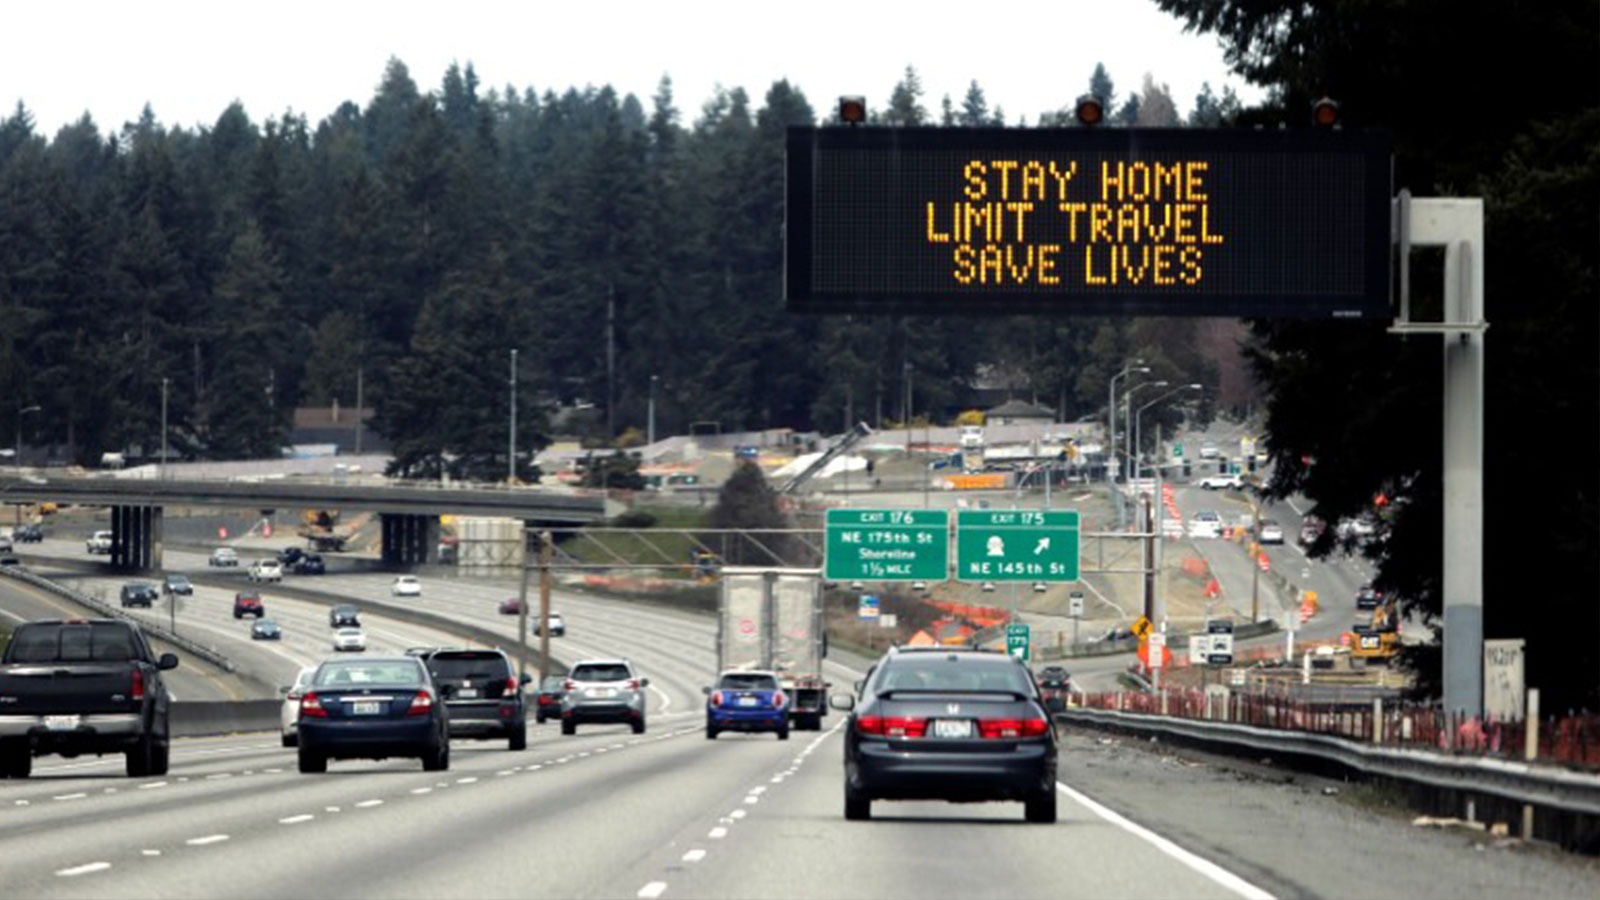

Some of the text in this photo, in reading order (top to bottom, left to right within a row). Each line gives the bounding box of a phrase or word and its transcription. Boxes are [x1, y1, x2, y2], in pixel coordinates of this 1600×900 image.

[964, 160, 1208, 201] STAY HOME
[927, 202, 1223, 243] LIMIT TRAVEL
[954, 244, 1202, 284] SAVE LIVES
[860, 511, 914, 524] EXIT 176
[990, 512, 1045, 525] EXIT 175
[841, 531, 933, 544] NE 175th St
[858, 547, 917, 559] Shoreline
[886, 564, 912, 574] MILE
[970, 562, 1065, 574] NE 145th St
